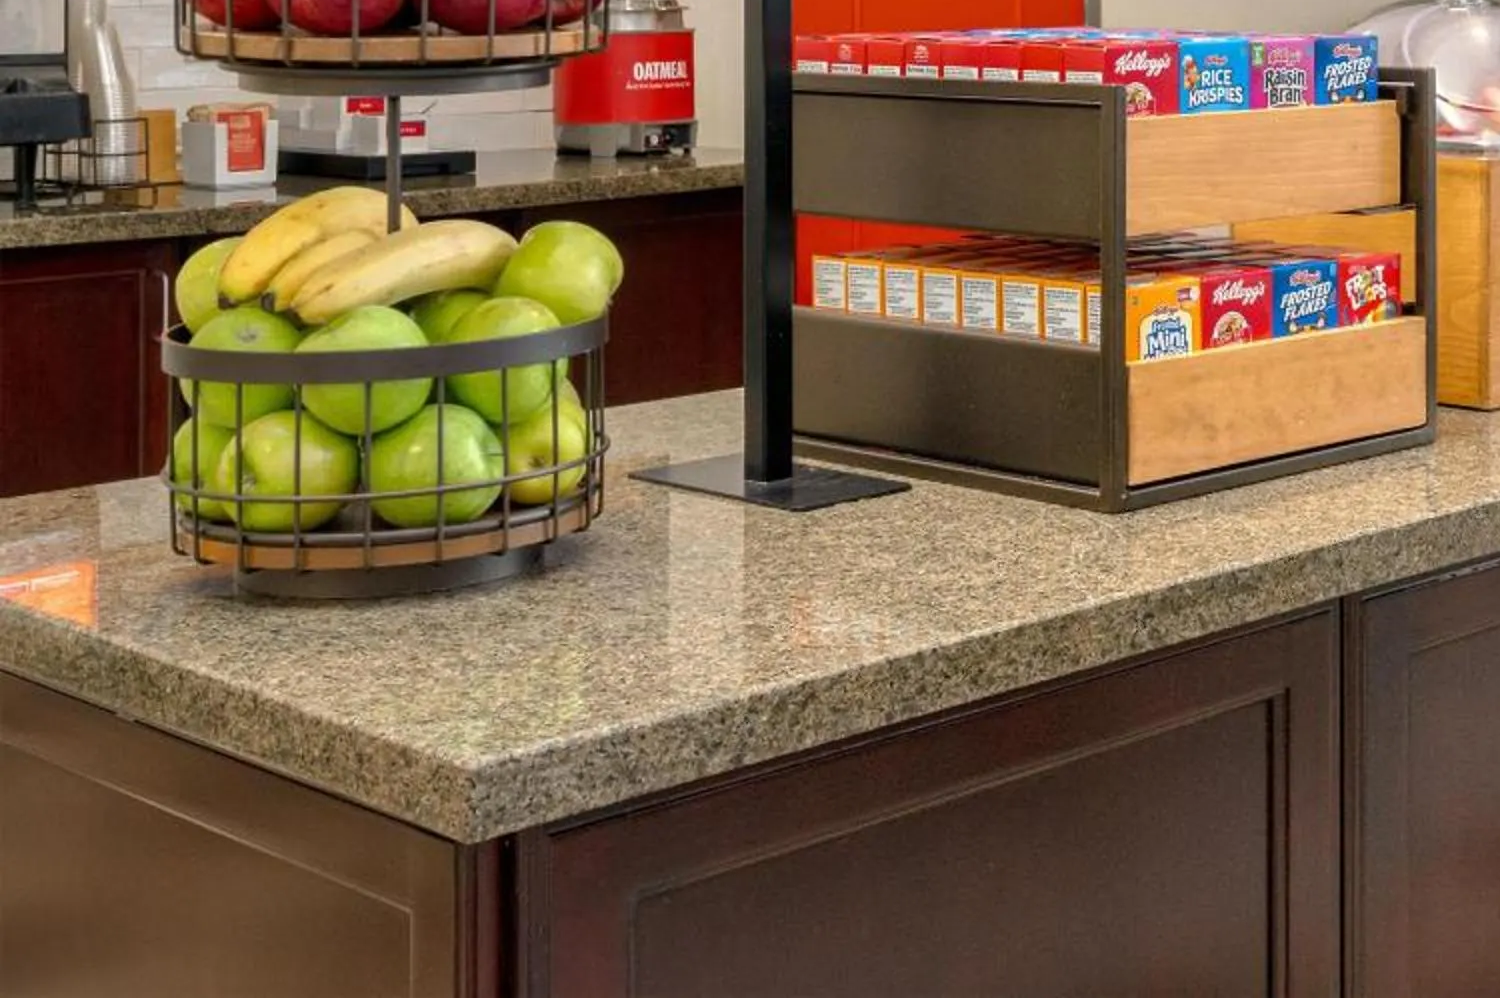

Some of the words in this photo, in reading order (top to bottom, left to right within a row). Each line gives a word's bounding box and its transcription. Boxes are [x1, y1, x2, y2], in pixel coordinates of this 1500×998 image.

[633, 60, 688, 81] OATMEAL
[1114, 50, 1171, 77] Kellogg's
[1324, 56, 1373, 80] FROSTED
[1201, 69, 1233, 87] RICE
[1264, 67, 1307, 91] Raisin
[1327, 72, 1367, 91] FLAKES
[1188, 86, 1243, 109] KRISPIES
[1268, 88, 1302, 108] Bran
[1213, 279, 1265, 307] Kellogg's
[1280, 281, 1333, 309] FROSTED
[1284, 297, 1327, 322] FLAKES
[1147, 325, 1188, 357] Mini
